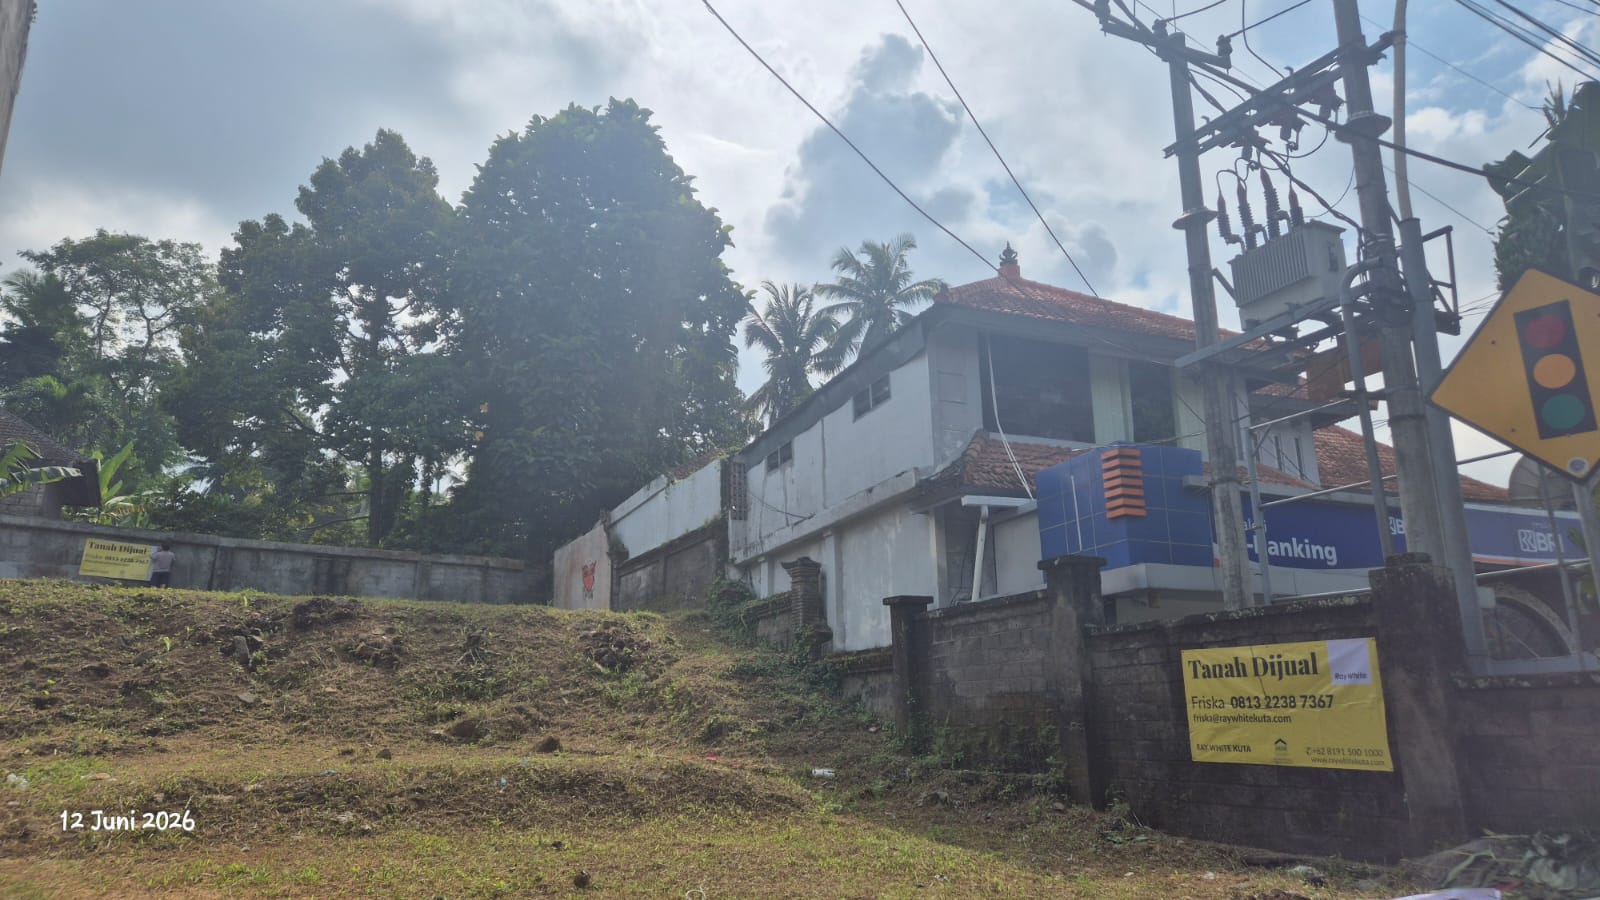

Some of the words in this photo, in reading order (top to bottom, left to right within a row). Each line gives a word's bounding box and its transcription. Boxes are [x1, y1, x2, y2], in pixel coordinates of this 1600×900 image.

[89, 542, 117, 552] Tanah
[119, 544, 147, 555] Dijual
[1246, 537, 1338, 566] -anking
[1188, 656, 1248, 679] Tanah
[1252, 652, 1319, 681] Dijual
[1191, 696, 1225, 710] Friska
[1230, 696, 1261, 709] 0813
[1265, 695, 1297, 709] 2238
[1299, 694, 1334, 709] 7367
[1193, 713, 1292, 725] friska@raywhitekuta.com
[1233, 744, 1252, 752] KUTA
